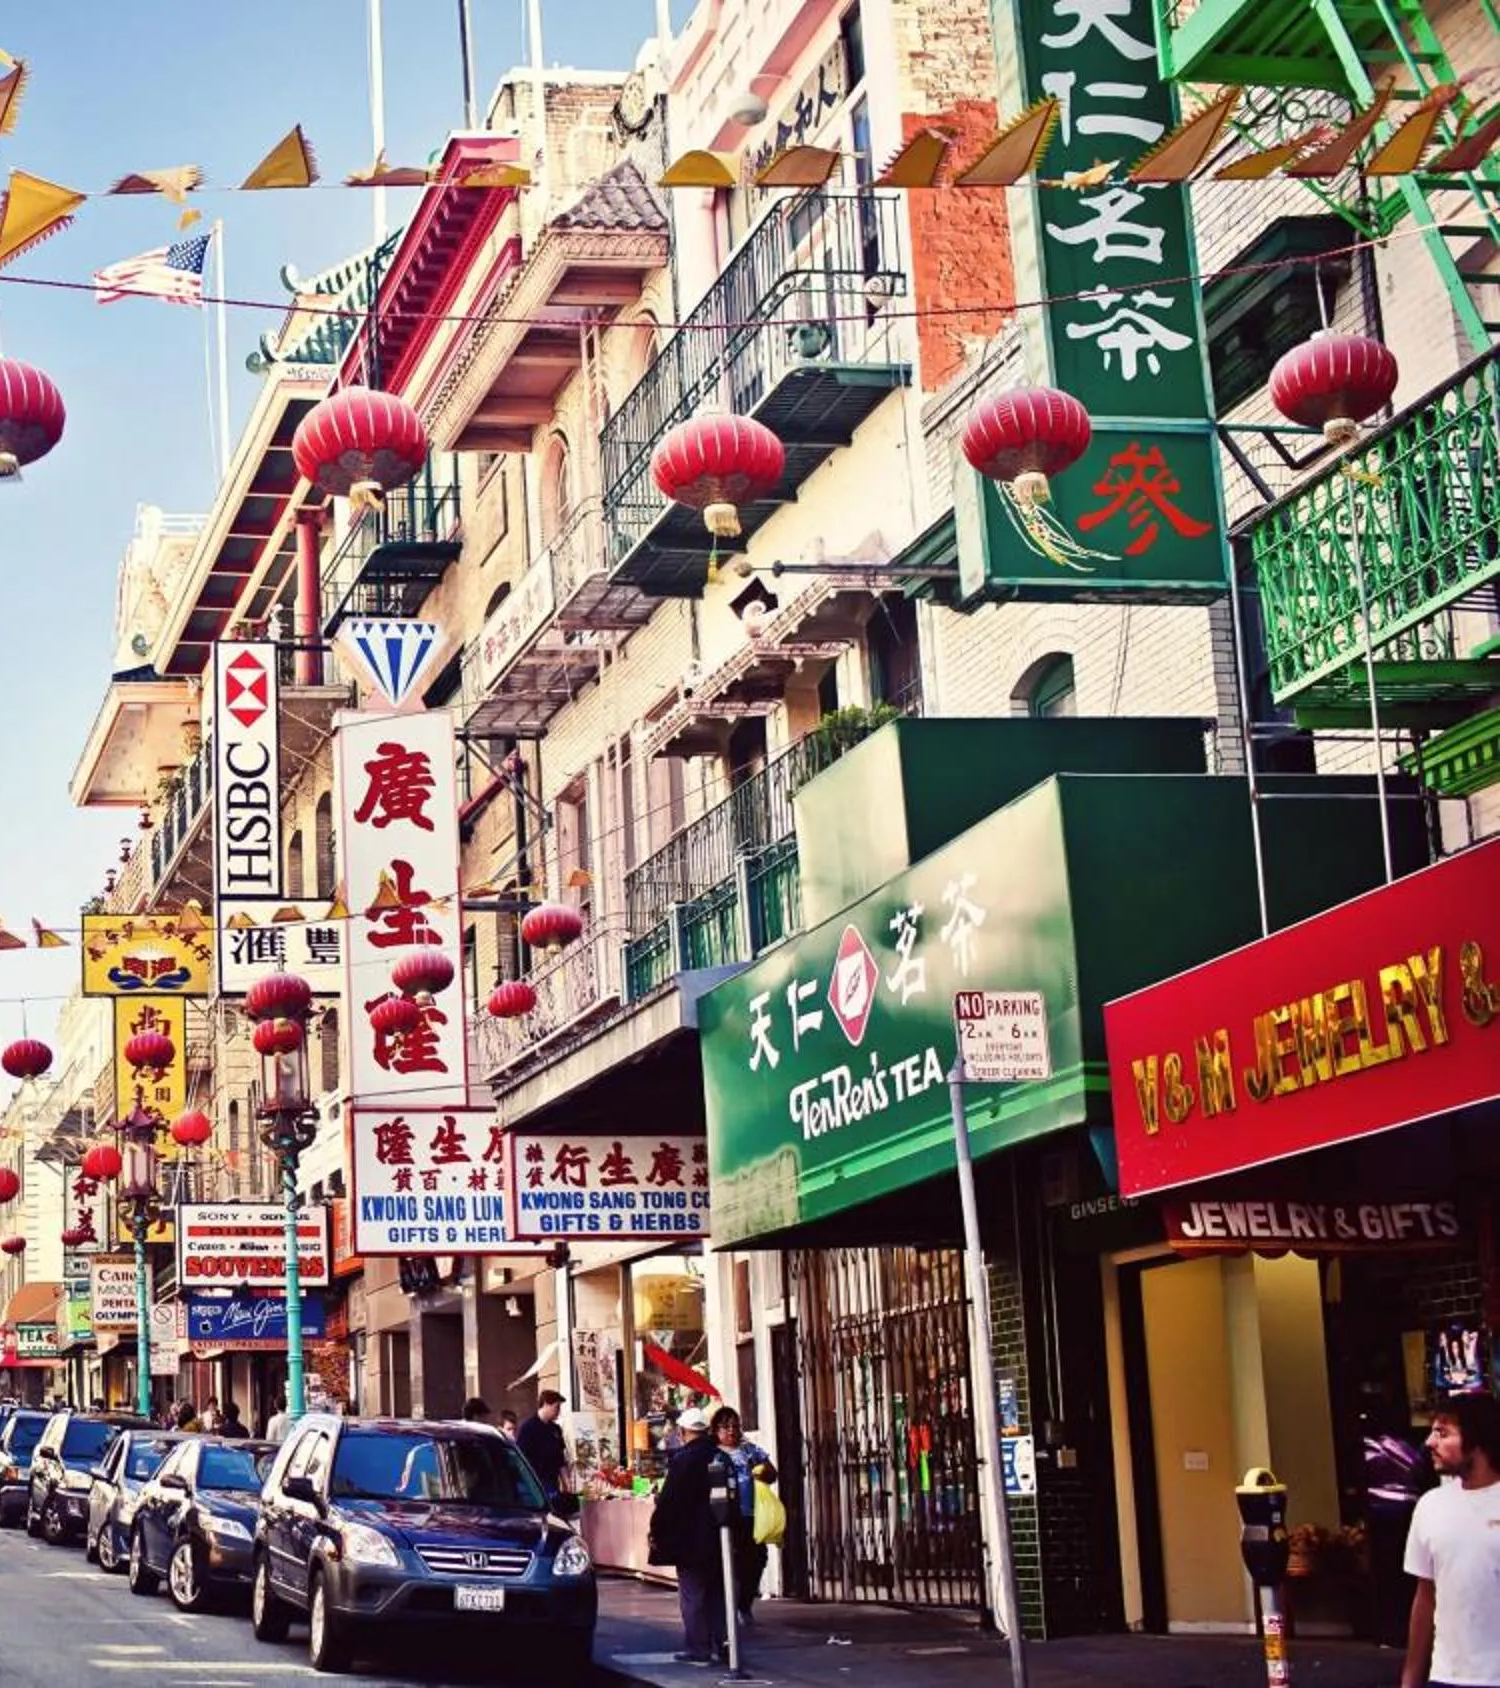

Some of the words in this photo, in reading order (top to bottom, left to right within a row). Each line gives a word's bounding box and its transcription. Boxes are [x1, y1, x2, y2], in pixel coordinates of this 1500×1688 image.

[225, 741, 272, 889] HSBC
[959, 993, 983, 1017] NO
[986, 999, 1041, 1016] PARKING
[1244, 944, 1449, 1102] JEWELRY
[891, 1047, 945, 1104] TEA
[362, 1195, 418, 1222] KWONG
[424, 1196, 467, 1222] SANG
[520, 1191, 585, 1211] KWONG
[588, 1191, 637, 1210] SANG
[640, 1191, 688, 1210] TONG
[197, 1211, 240, 1221] SONY
[540, 1214, 601, 1232] GIFTS
[609, 1215, 623, 1231] &
[631, 1213, 701, 1231] HERBS
[1181, 1201, 1329, 1238] JEWELRY
[1335, 1206, 1358, 1238] &
[1357, 1202, 1460, 1240] GIFTS
[388, 1226, 439, 1243] GIFTS
[446, 1227, 457, 1242] &
